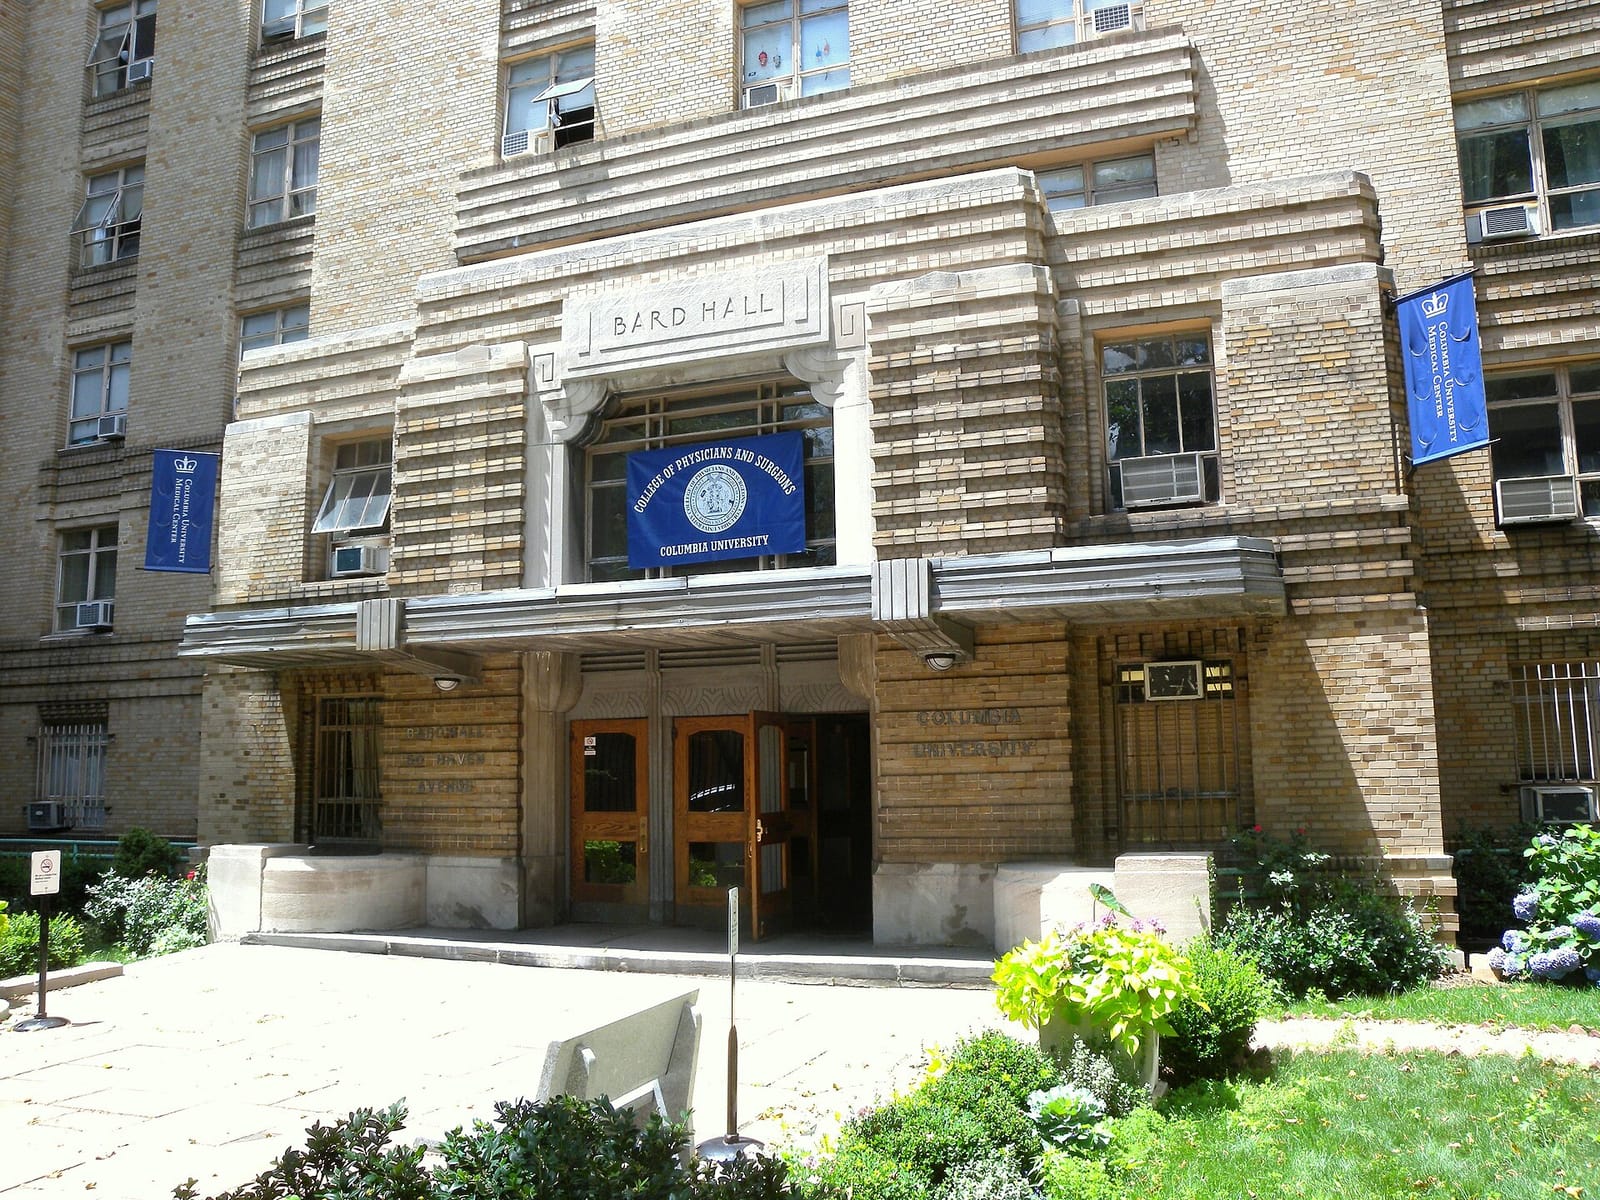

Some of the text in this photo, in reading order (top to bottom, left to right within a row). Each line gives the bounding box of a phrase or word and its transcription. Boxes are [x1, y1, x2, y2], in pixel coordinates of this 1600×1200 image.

[614, 293, 774, 336] BARD HALL
[1427, 325, 1443, 418] MEDICAL CENTER
[1438, 321, 1458, 442] COLUMBIA UNIVERSITY
[171, 478, 184, 543] MEDICAL CENTER
[633, 474, 665, 513] COLLEGE
[663, 464, 676, 479] OF
[675, 447, 733, 471] PHYSICIANS
[734, 448, 755, 463] AND
[754, 454, 797, 496] SURGEONS
[178, 479, 193, 564] COLUMBIA UNIVERSITY
[660, 534, 769, 557] COLUMBIA UNIVERSITY
[913, 740, 1035, 757] UNIVERSITY
[917, 708, 1022, 725] COLUMBIA
